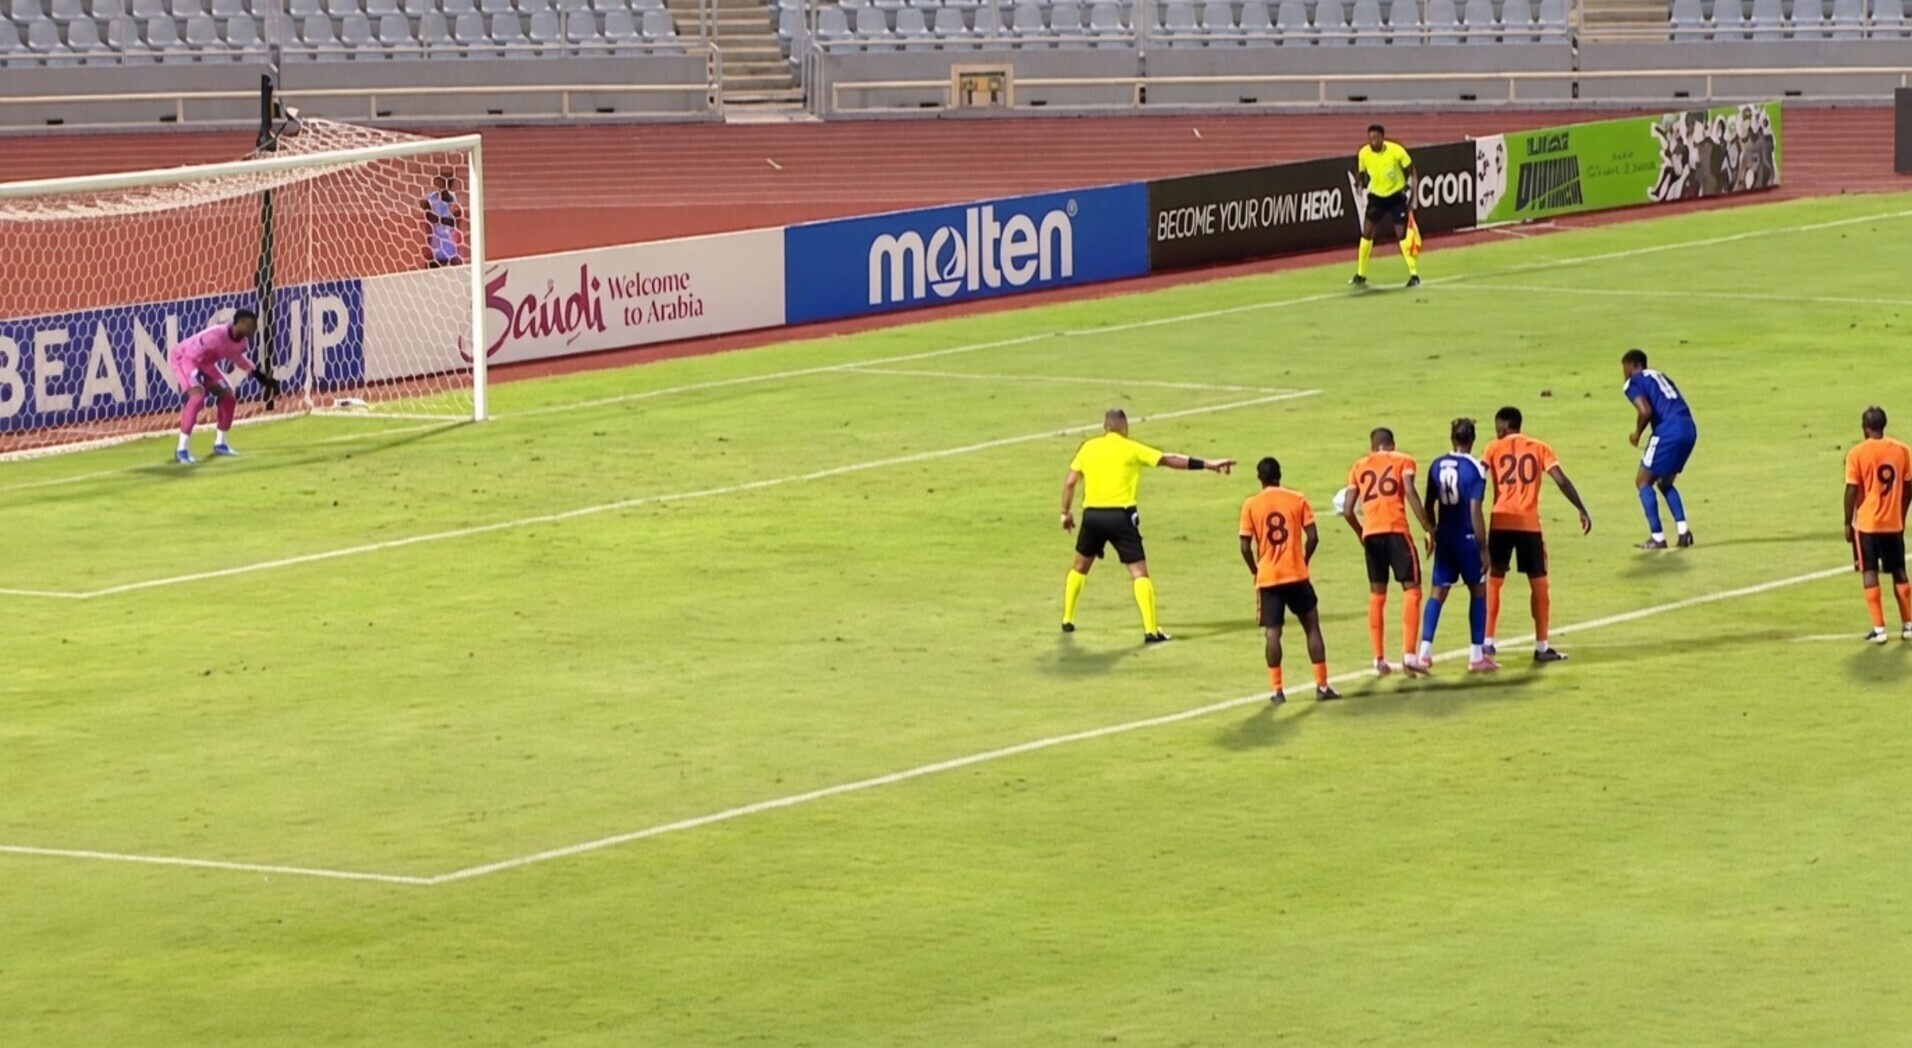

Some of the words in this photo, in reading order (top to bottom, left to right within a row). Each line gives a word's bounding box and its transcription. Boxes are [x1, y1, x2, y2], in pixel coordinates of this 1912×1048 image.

[1405, 170, 1473, 208] cron
[1157, 203, 1217, 241] BECOME
[1220, 198, 1257, 232] YOUR
[1260, 193, 1300, 228] OWN
[1300, 187, 1344, 221] HERO.
[608, 271, 690, 300] Welcome
[624, 301, 643, 327] to
[647, 293, 704, 323] Arabia
[1359, 465, 1399, 503] 26
[1499, 453, 1538, 485] 20
[1876, 464, 1896, 498] 9
[1265, 511, 1289, 546] 8
